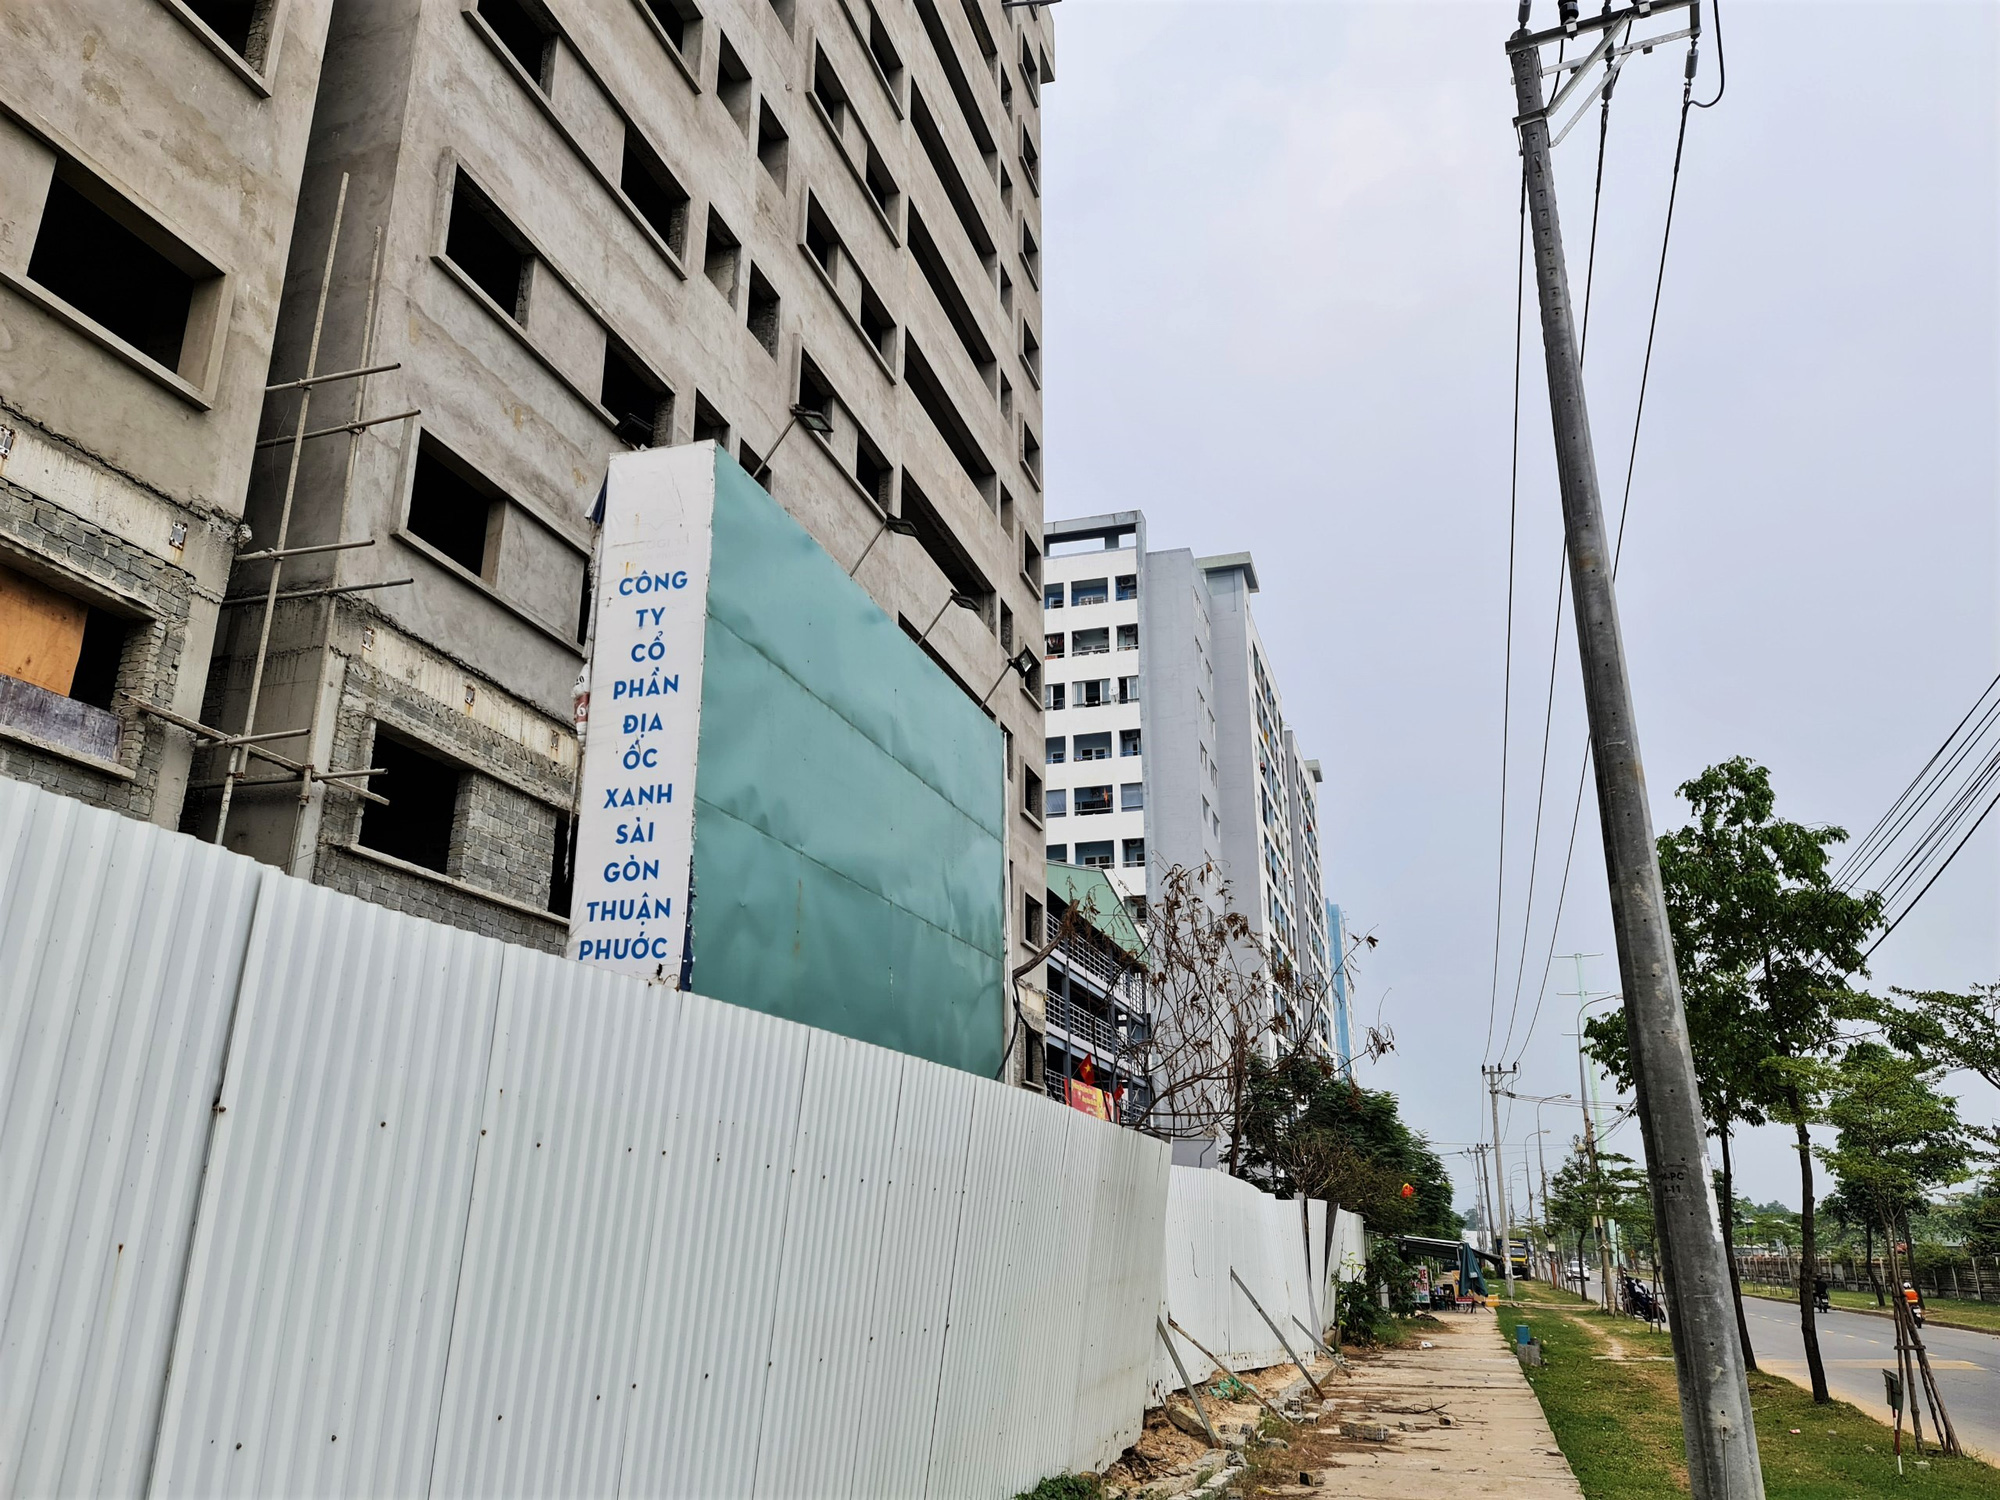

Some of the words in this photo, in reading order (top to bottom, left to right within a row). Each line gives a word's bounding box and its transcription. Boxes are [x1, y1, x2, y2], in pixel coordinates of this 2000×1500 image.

[619, 570, 688, 596] CÔNG
[636, 607, 666, 627] TY
[631, 630, 665, 662] CỔ
[613, 667, 679, 700] PHẦN
[623, 712, 663, 738] ĐỊA
[623, 739, 658, 770] ỐC
[603, 783, 673, 809] XANH
[615, 817, 655, 845] SÀI
[603, 854, 660, 883] GÒN
[586, 892, 671, 926] THUẬN
[578, 931, 668, 961] PHƯỚC
